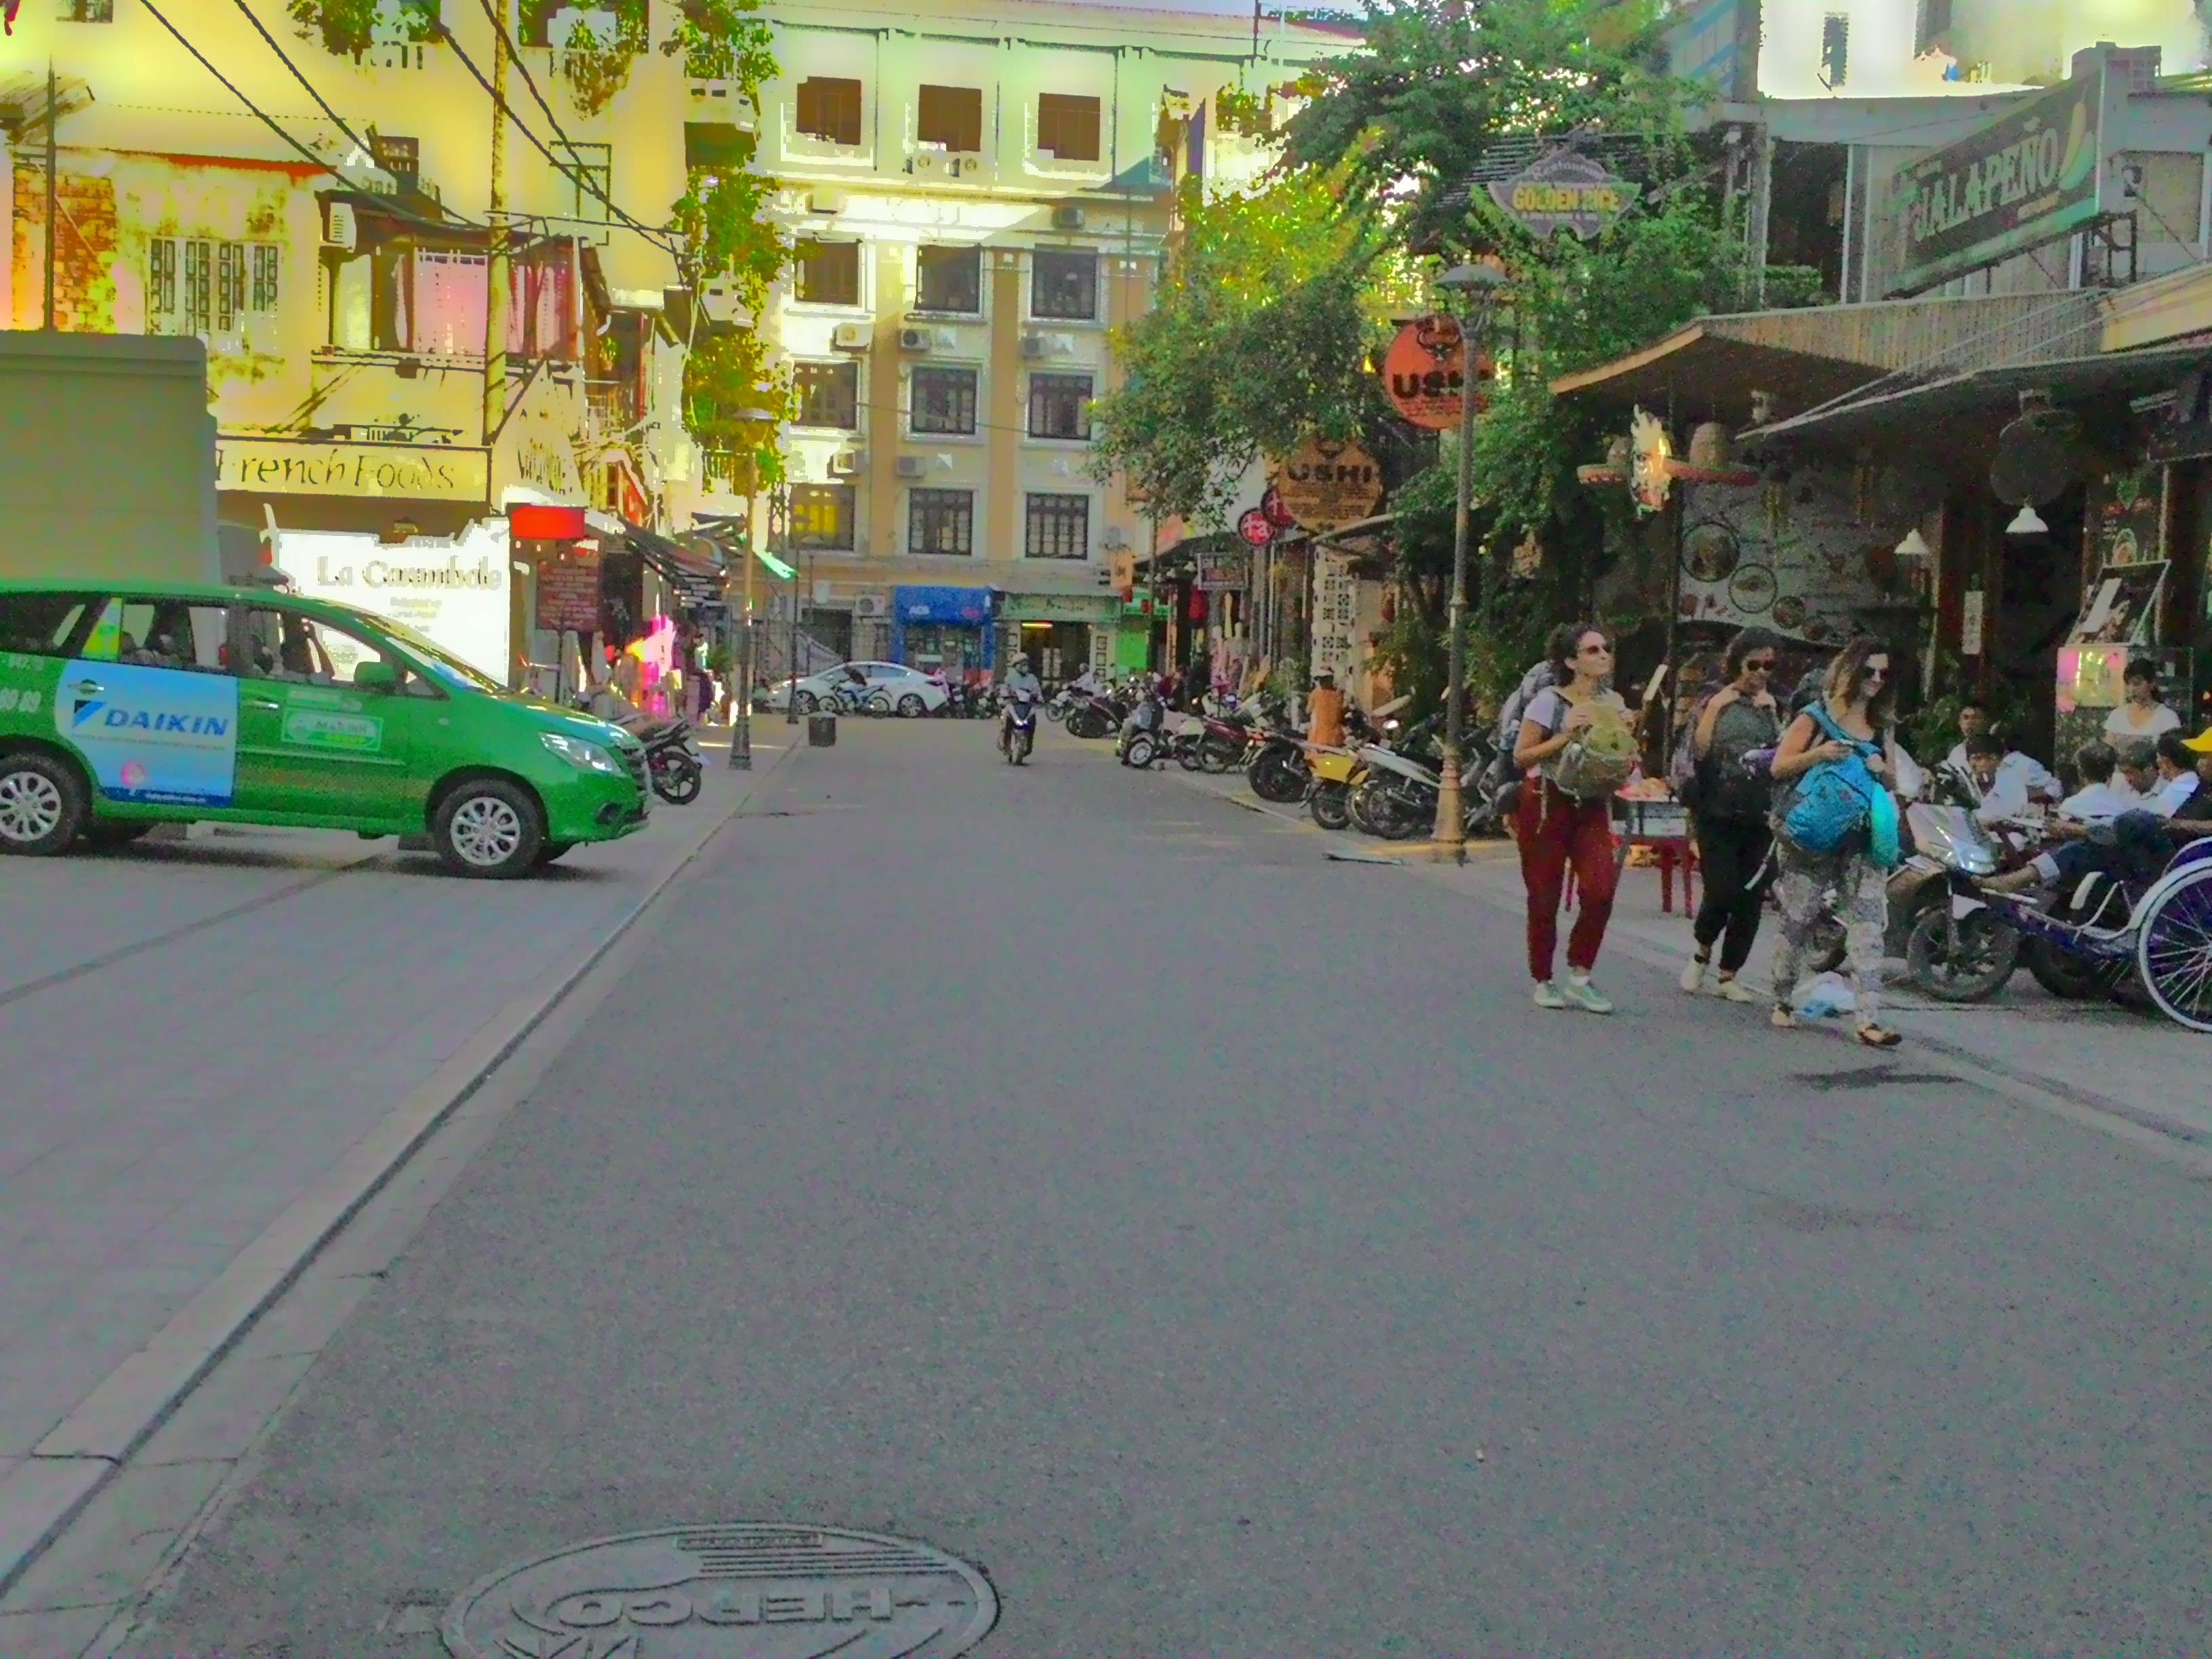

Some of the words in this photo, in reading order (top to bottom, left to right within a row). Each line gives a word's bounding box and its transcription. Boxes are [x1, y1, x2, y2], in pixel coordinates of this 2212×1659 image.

[1912, 116, 2058, 242] JALAPEÑO
[1512, 186, 1578, 212] GOLDEN
[104, 708, 229, 736] DAIKIN
